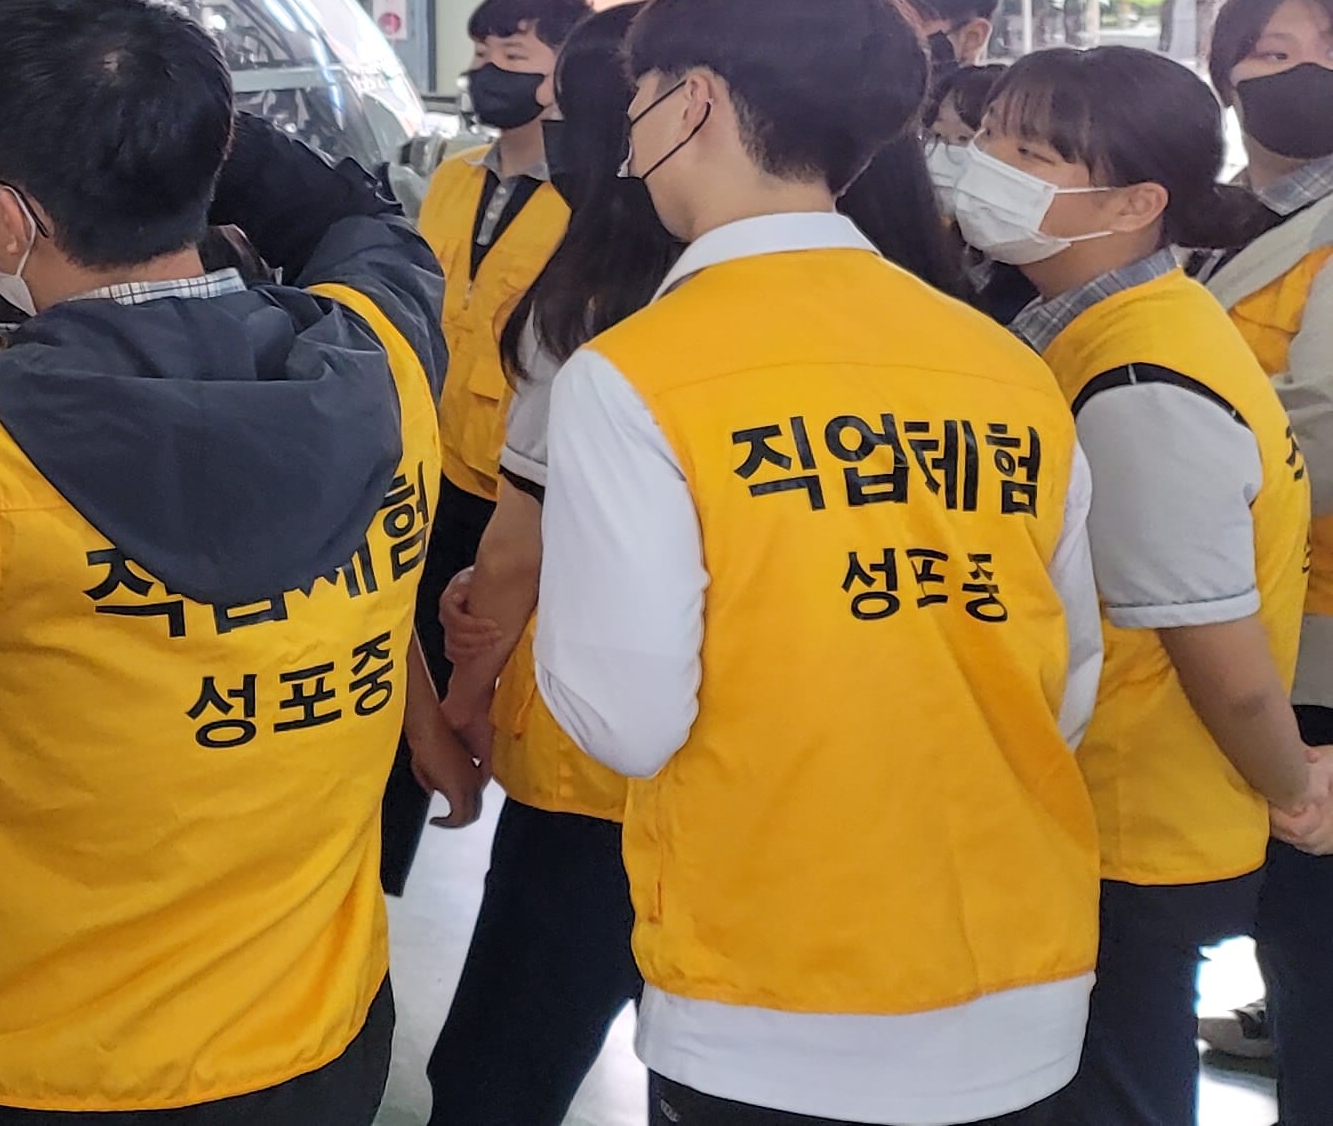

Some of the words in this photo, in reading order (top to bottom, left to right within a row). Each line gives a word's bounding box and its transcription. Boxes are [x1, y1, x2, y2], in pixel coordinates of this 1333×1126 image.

[731, 412, 1042, 519] 직업체험
[841, 547, 1009, 623] 성포중
[186, 630, 395, 749] 성포중
